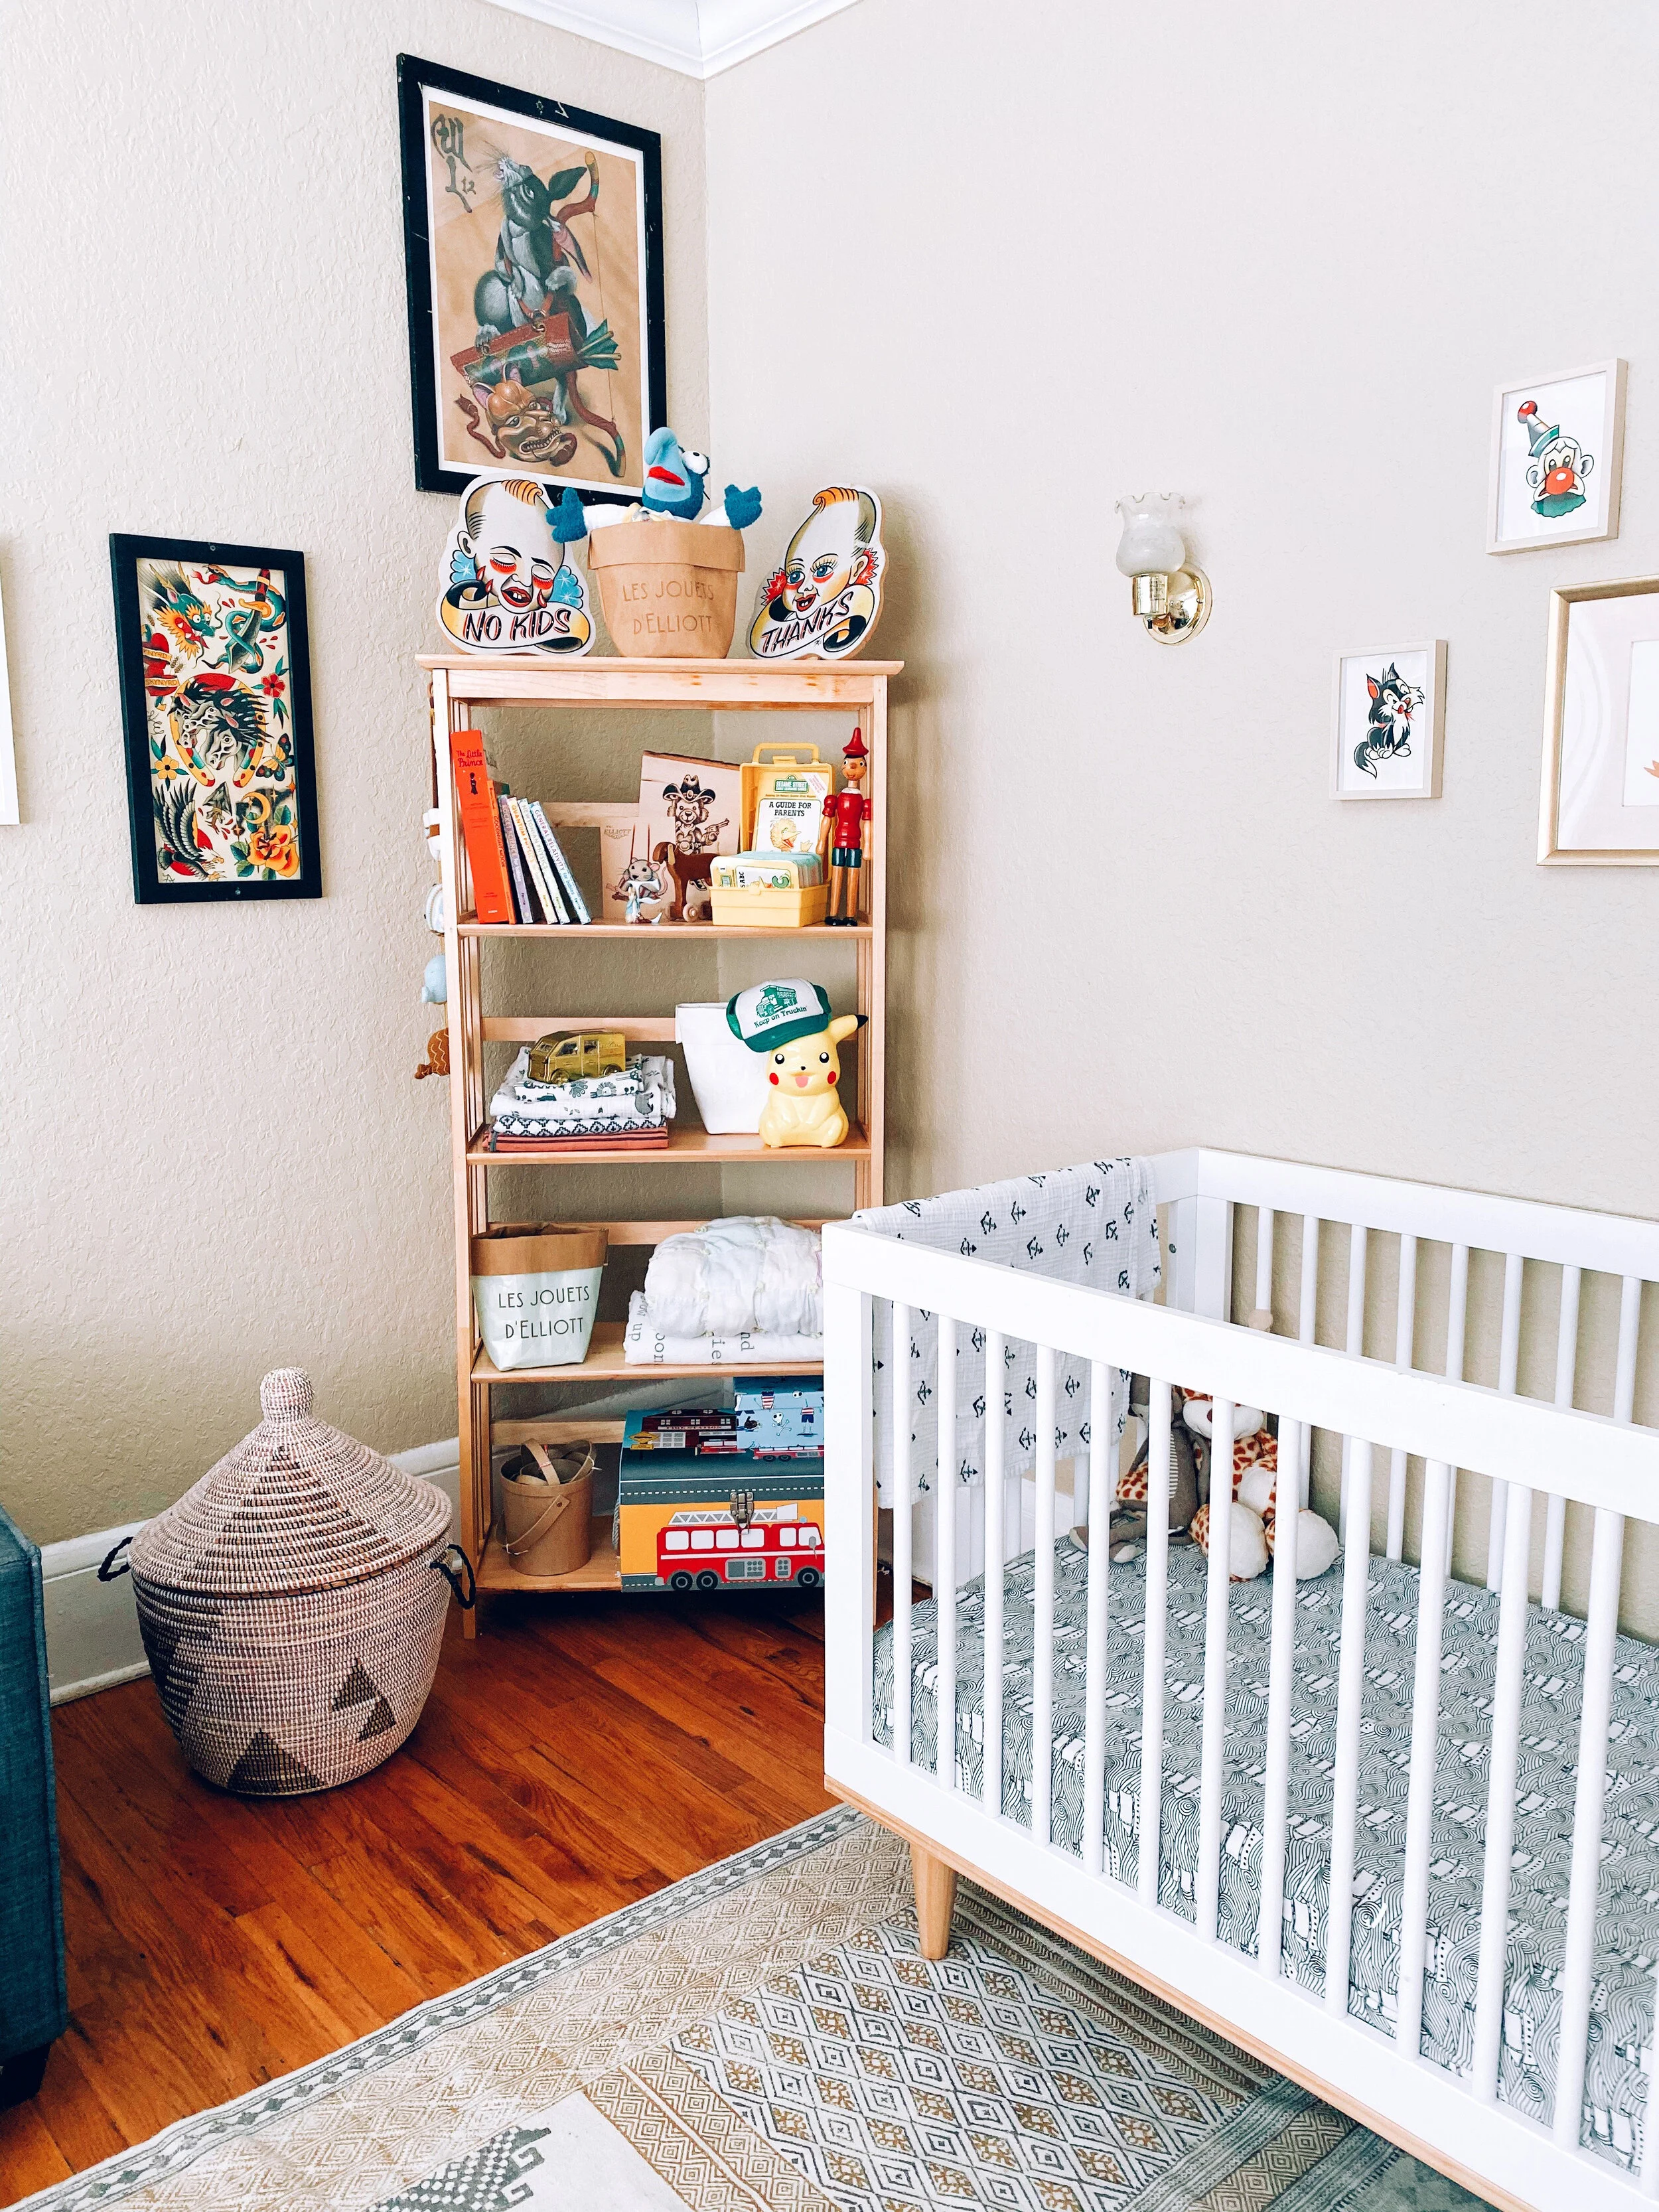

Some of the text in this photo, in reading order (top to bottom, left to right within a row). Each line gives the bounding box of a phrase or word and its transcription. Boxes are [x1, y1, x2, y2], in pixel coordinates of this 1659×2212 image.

[622, 581, 714, 602] LES JOUETS
[463, 607, 571, 642] NO KIDS
[761, 591, 854, 653] THANKS
[458, 757, 484, 767] Prince
[467, 749, 483, 759] Little
[512, 804, 526, 836] QUANTUM
[535, 810, 550, 839] GENERAL
[547, 838, 565, 871] RELATIVITY
[754, 1017, 770, 1028] Keep
[780, 1005, 808, 1017] Truckin'
[498, 1286, 590, 1308] LES JOUETS
[505, 1317, 583, 1339] D'ELLIOTT
[628, 1323, 642, 1341] up
